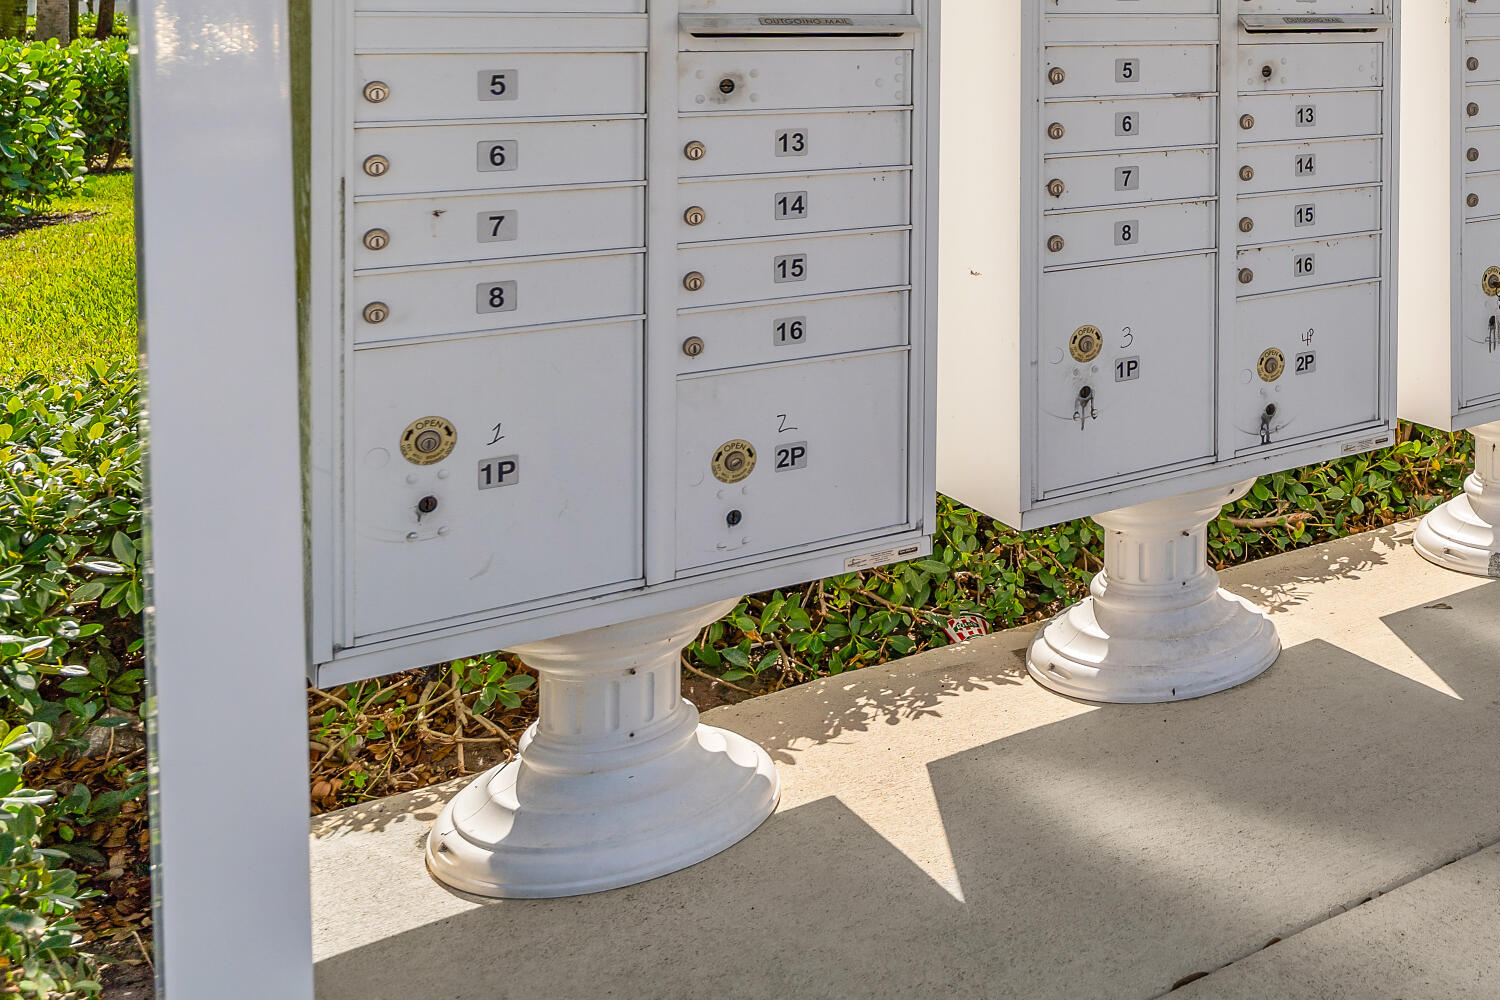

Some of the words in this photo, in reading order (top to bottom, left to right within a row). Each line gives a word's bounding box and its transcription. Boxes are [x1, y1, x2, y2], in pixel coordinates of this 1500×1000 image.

[764, 17, 821, 25] OUTGOING
[1122, 62, 1133, 79] 5
[490, 74, 506, 96] 5
[1122, 115, 1132, 132] 6
[1297, 107, 1314, 124] 13
[778, 132, 805, 153] 13
[489, 145, 506, 167] 6
[1296, 157, 1314, 173] 14
[1122, 170, 1132, 187] 7
[777, 195, 805, 216] 14
[1296, 207, 1314, 224] 15
[488, 215, 505, 237] 7
[1121, 224, 1132, 241] 8
[777, 258, 804, 279] 15
[1296, 257, 1313, 273] 16
[488, 286, 505, 308] 8
[776, 320, 803, 342] 16
[1077, 327, 1096, 336] OPEN
[1120, 326, 1134, 349] 3
[1116, 360, 1138, 378] 1P
[1296, 354, 1315, 372] 2P
[415, 419, 444, 430] OPEN
[723, 442, 746, 453] OPEN
[776, 446, 806, 469] 2P
[480, 460, 516, 485] 1P
